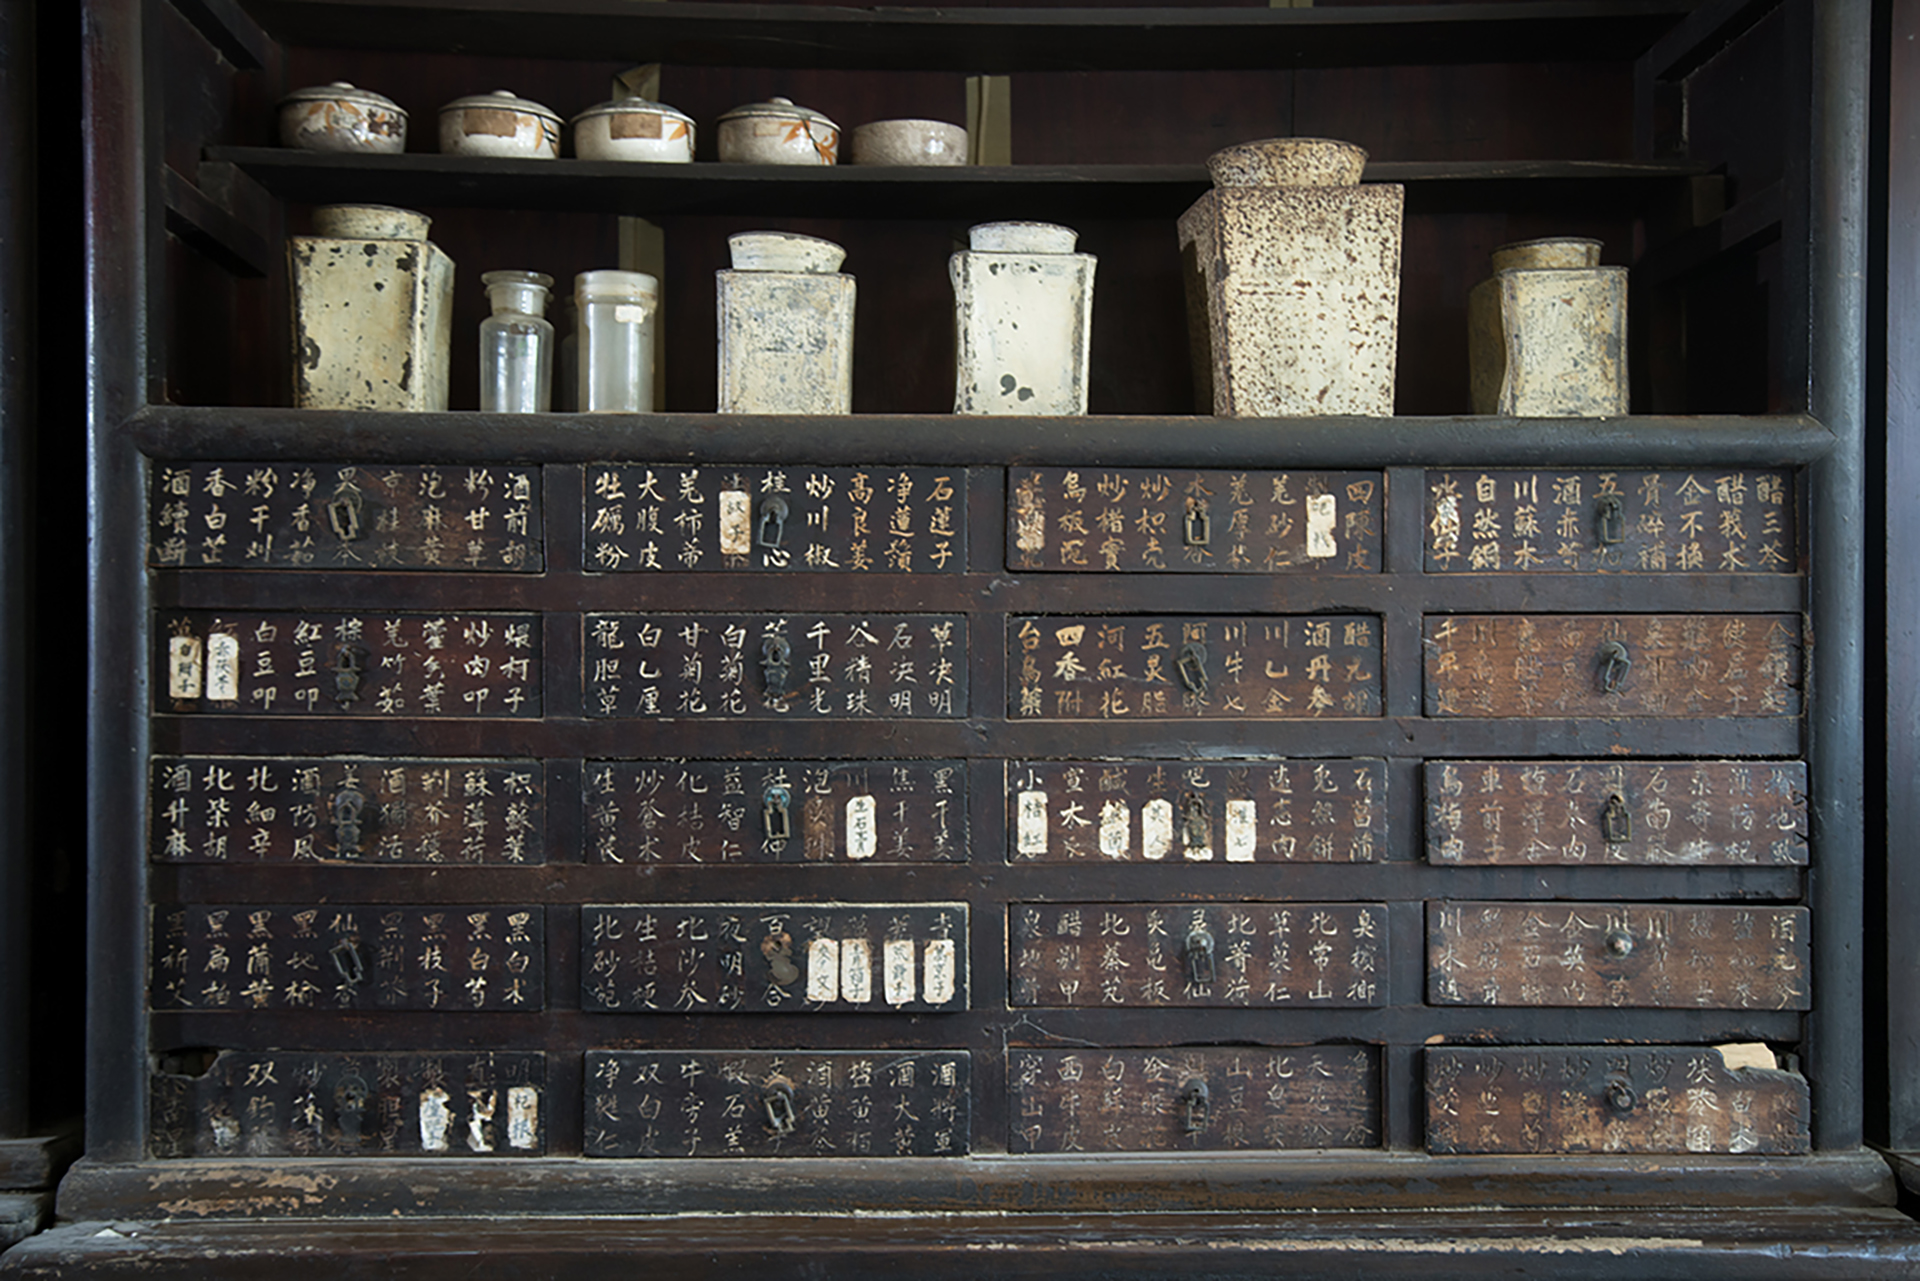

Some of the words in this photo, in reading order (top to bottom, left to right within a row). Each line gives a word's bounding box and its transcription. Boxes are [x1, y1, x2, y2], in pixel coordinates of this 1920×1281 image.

[464, 467, 494, 567] 粉甘草
[636, 469, 666, 570] 大腹皮
[925, 475, 955, 569] 石蓮子
[1468, 473, 1501, 570] 自然銅
[1512, 474, 1544, 570] 川蘇木
[676, 621, 709, 713] 甘菊花
[718, 623, 748, 715] 白菊花
[806, 620, 832, 714] 千里光
[161, 764, 192, 858] 酒升麻
[203, 765, 236, 860] 北柴胡
[245, 765, 278, 860] 北細辛
[718, 766, 745, 861] 益智仁
[716, 915, 748, 1010] 夜明砂
[760, 913, 792, 1007] 百合
[1308, 911, 1339, 1001] 北常山
